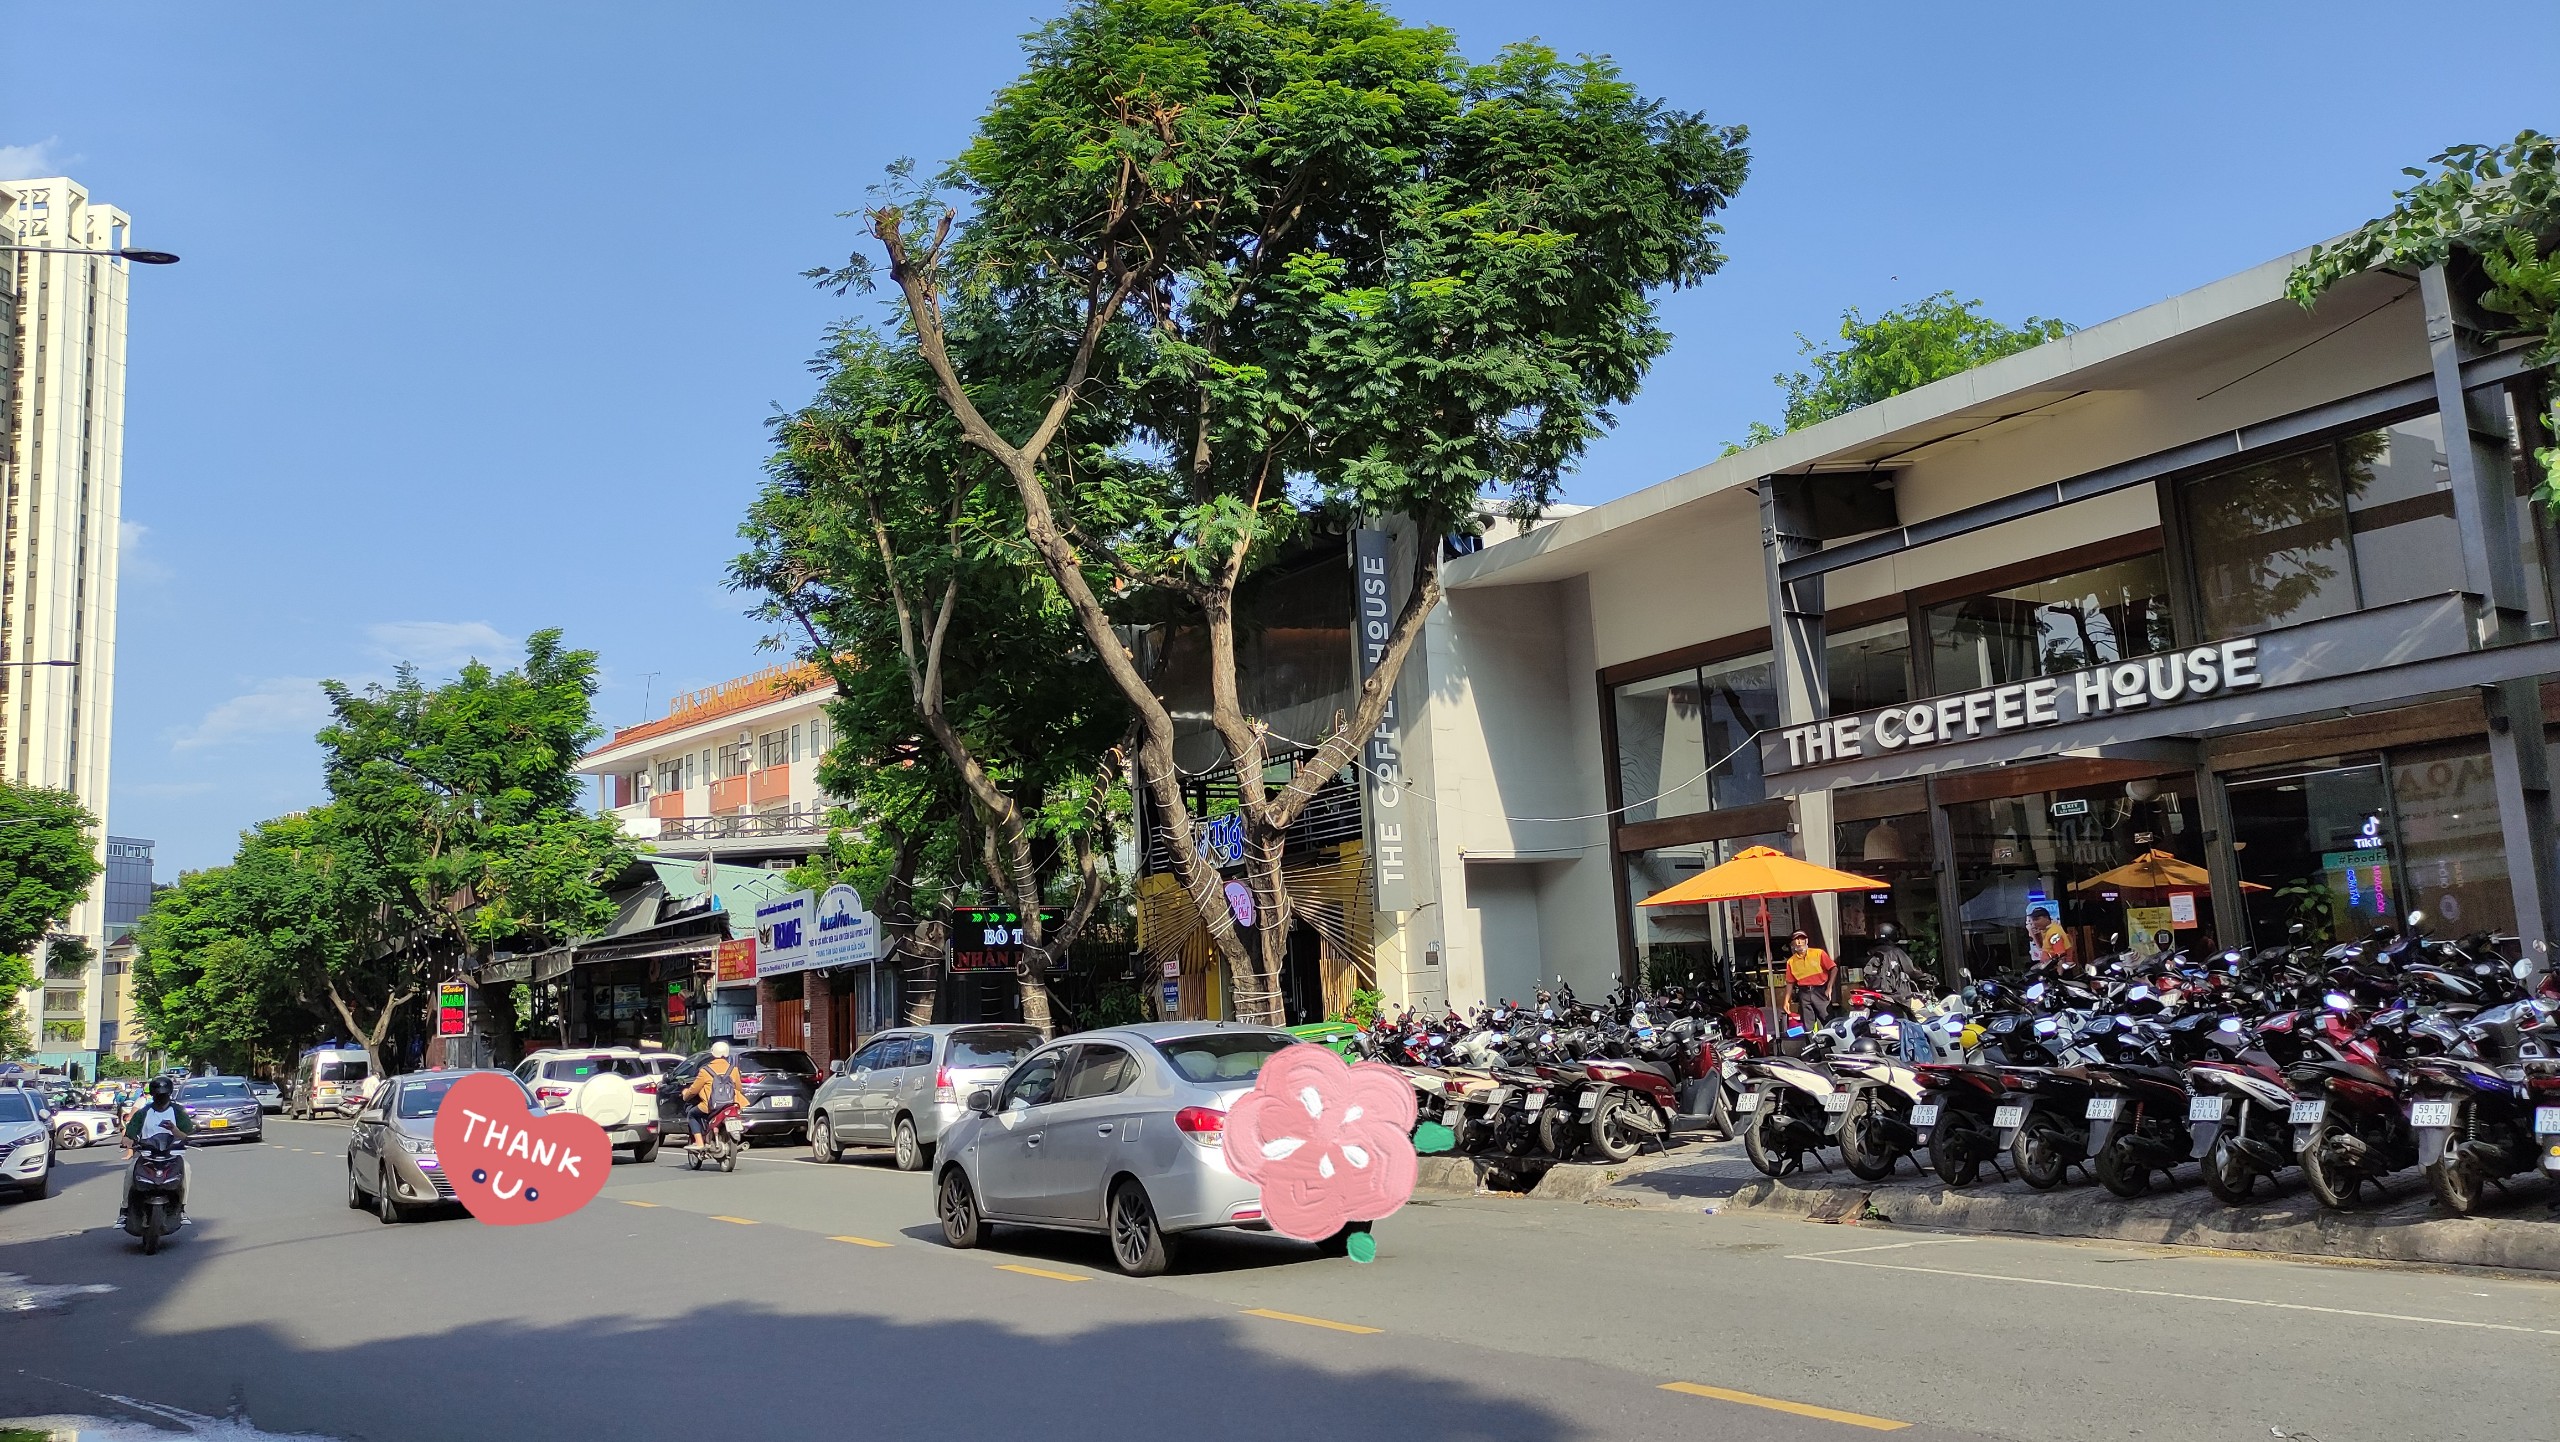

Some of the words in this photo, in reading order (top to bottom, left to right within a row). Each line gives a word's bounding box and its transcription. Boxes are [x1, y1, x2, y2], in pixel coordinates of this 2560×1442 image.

[1362, 555, 1389, 664] HOUSE
[1782, 716, 1863, 767] THE
[1874, 678, 2059, 750] COFFEE
[2075, 637, 2262, 716] HOUSE
[1373, 692, 1402, 809] COFFE
[1380, 823, 1405, 885] THE
[773, 917, 802, 951] BMG
[2542, 1109, 2560, 1120] 79-
